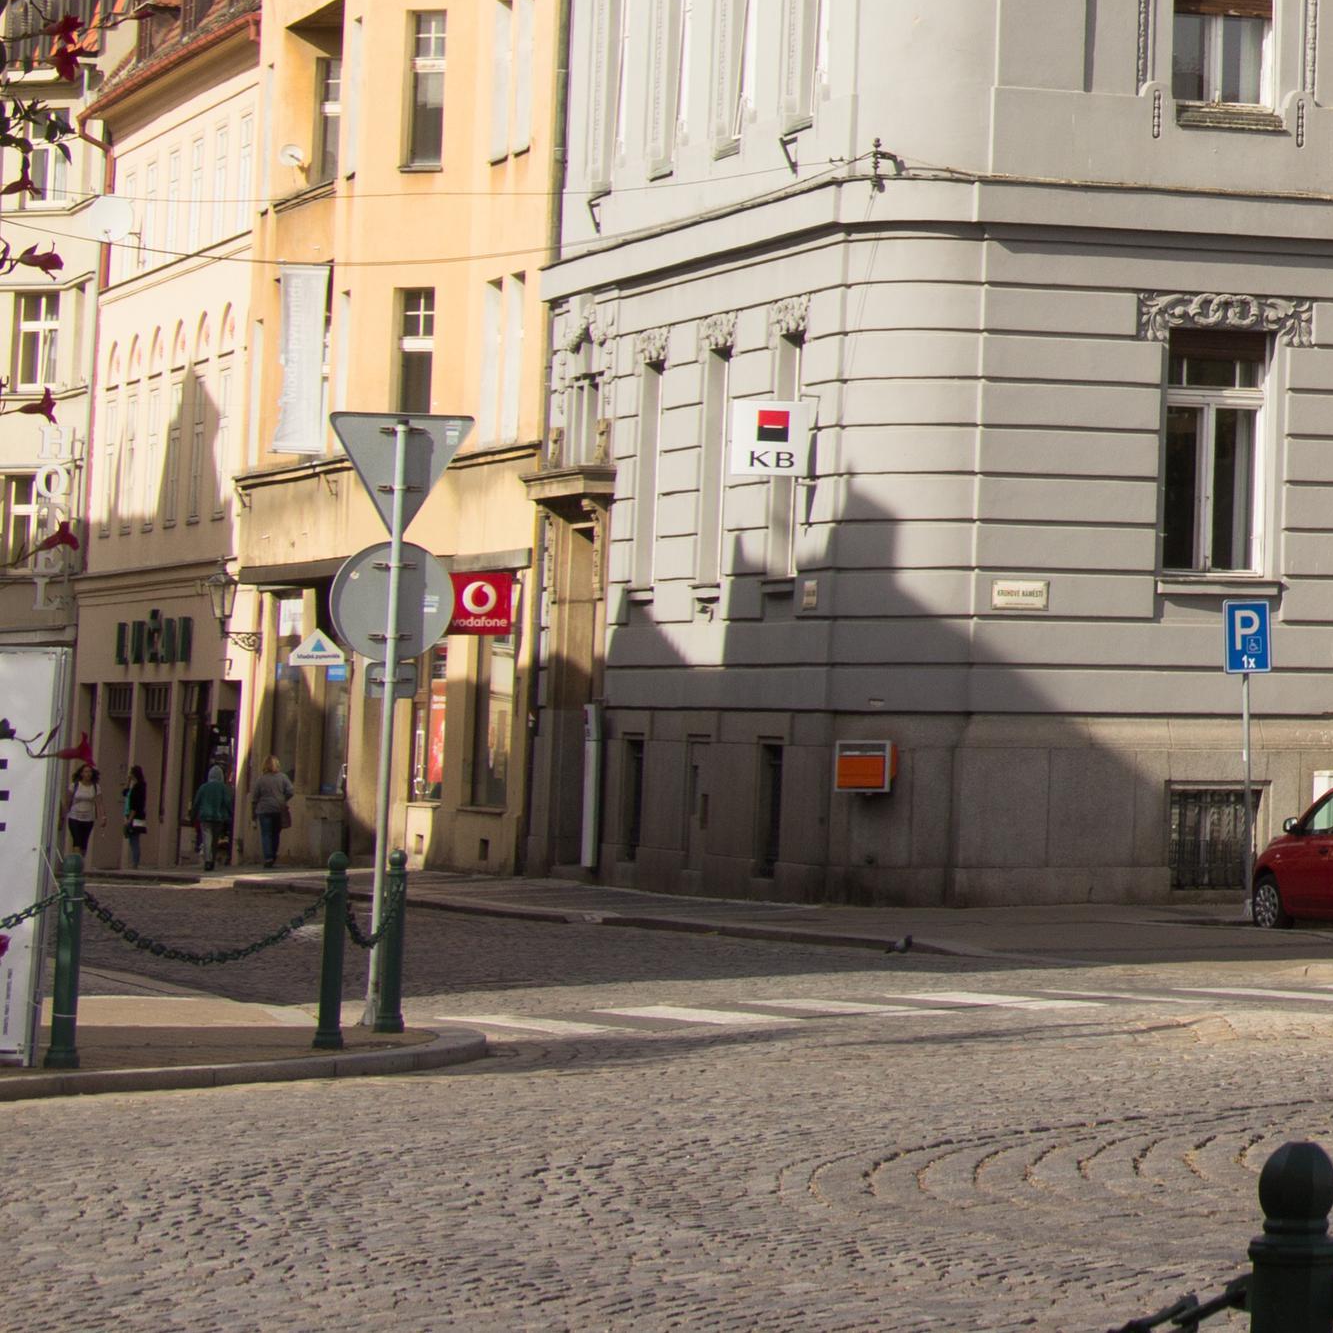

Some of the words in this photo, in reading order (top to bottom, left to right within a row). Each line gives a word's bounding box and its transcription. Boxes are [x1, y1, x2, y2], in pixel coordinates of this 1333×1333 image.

[749, 451, 795, 469] KB
[32, 426, 73, 611] HOTEL
[453, 616, 508, 627] vodafone
[1235, 610, 1260, 650] P
[1242, 654, 1256, 669] 1x
